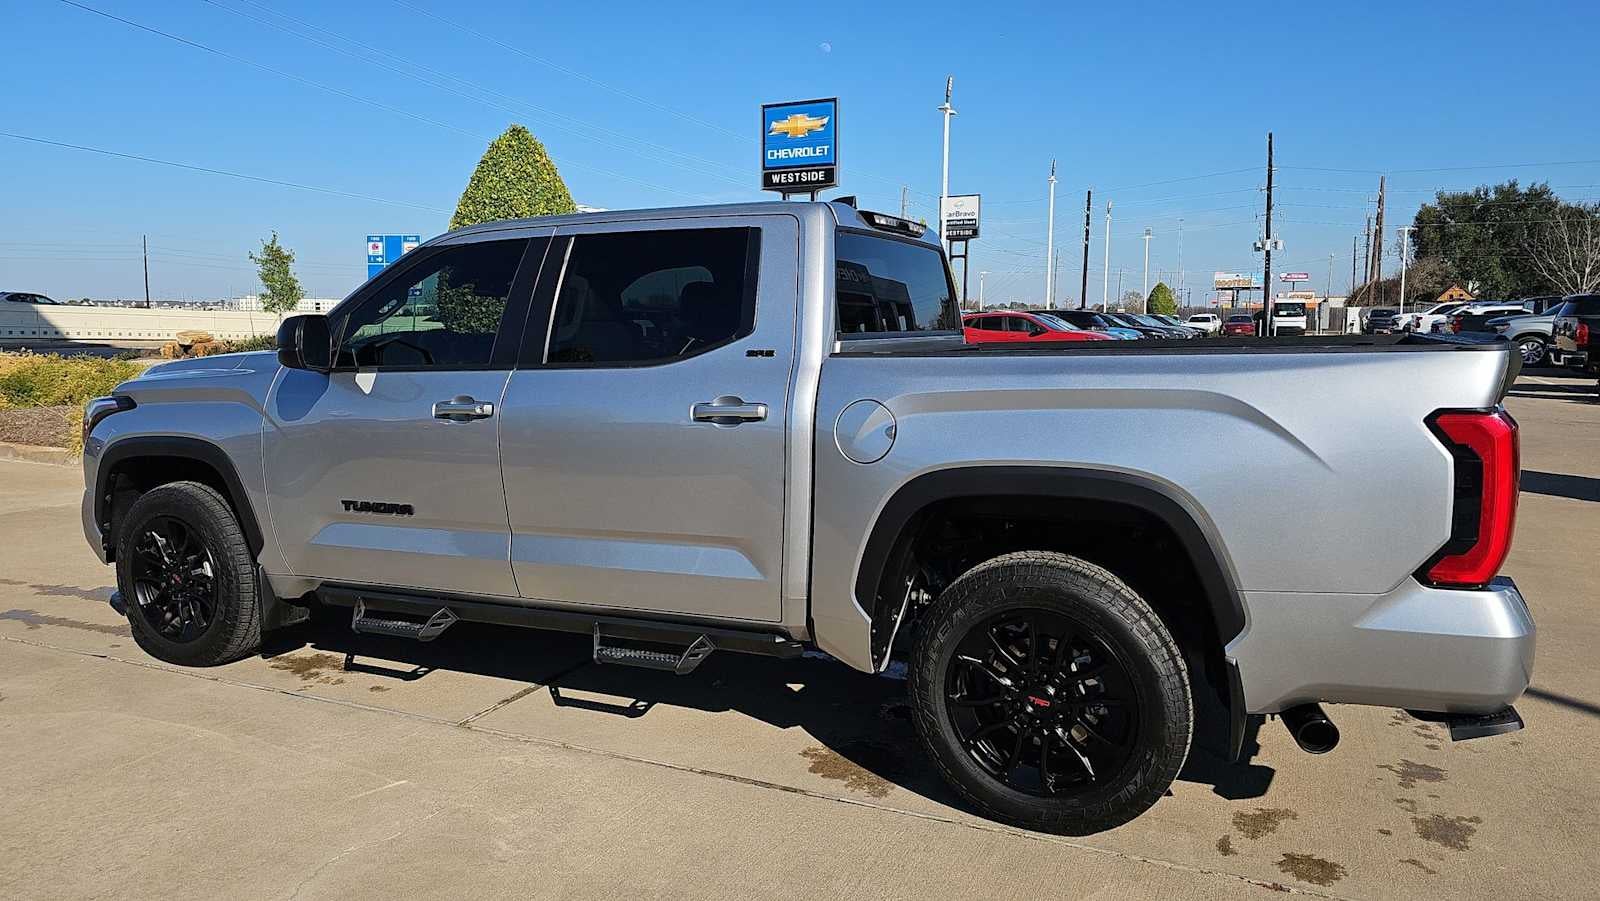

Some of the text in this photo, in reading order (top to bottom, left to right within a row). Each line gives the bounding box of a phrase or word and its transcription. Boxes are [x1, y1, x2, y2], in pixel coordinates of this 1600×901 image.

[767, 145, 830, 160] CHEVROLET
[771, 171, 825, 184] WESTSIDE
[340, 499, 415, 515] TUNDRA
[1028, 695, 1051, 707] TRD
